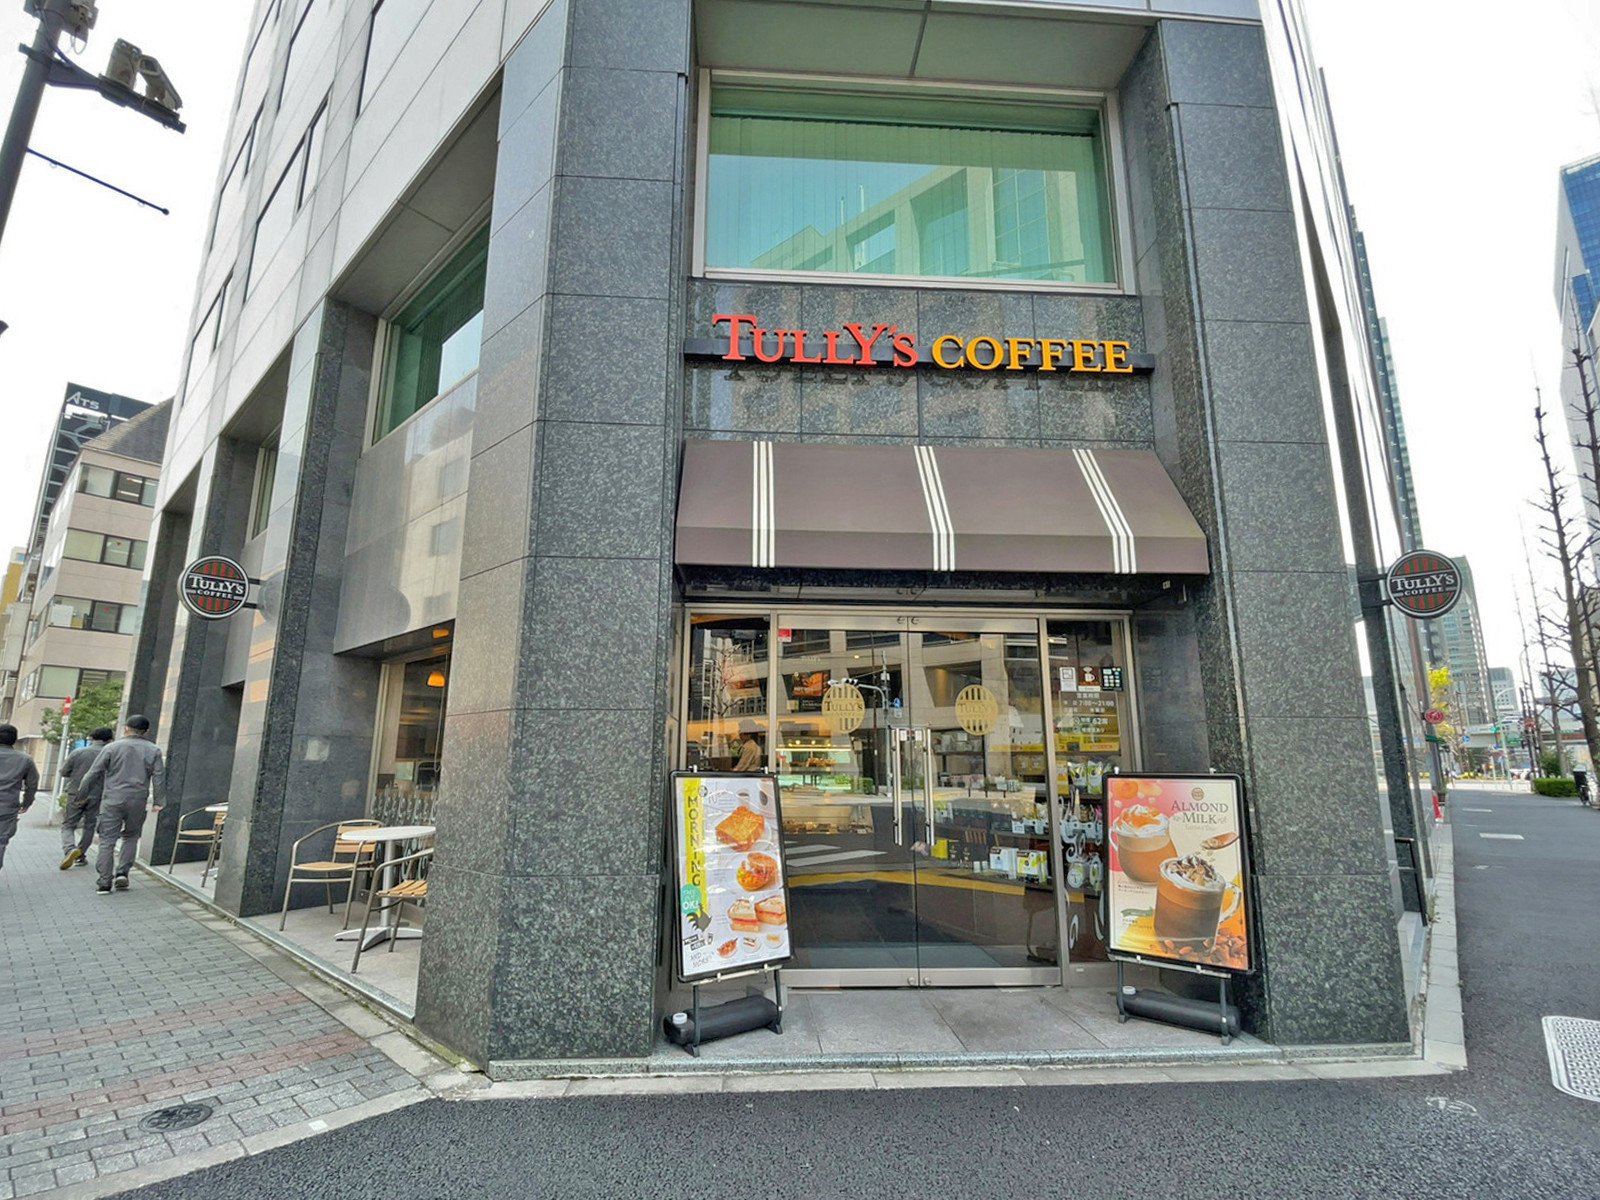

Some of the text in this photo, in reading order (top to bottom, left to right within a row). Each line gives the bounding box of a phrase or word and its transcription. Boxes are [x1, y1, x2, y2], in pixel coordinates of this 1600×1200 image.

[712, 314, 1134, 373] TULLY'S COFFEE
[66, 391, 100, 410] ATS
[189, 575, 244, 594] TULLY'S
[1391, 573, 1455, 590] TULLY'S
[197, 589, 233, 599] COFFEE
[1404, 586, 1445, 596] COFFEE
[824, 701, 863, 712] TULLY'S
[1171, 800, 1229, 813] ALMOND
[1182, 812, 1218, 825] MILK
[687, 796, 702, 887] MORNING
